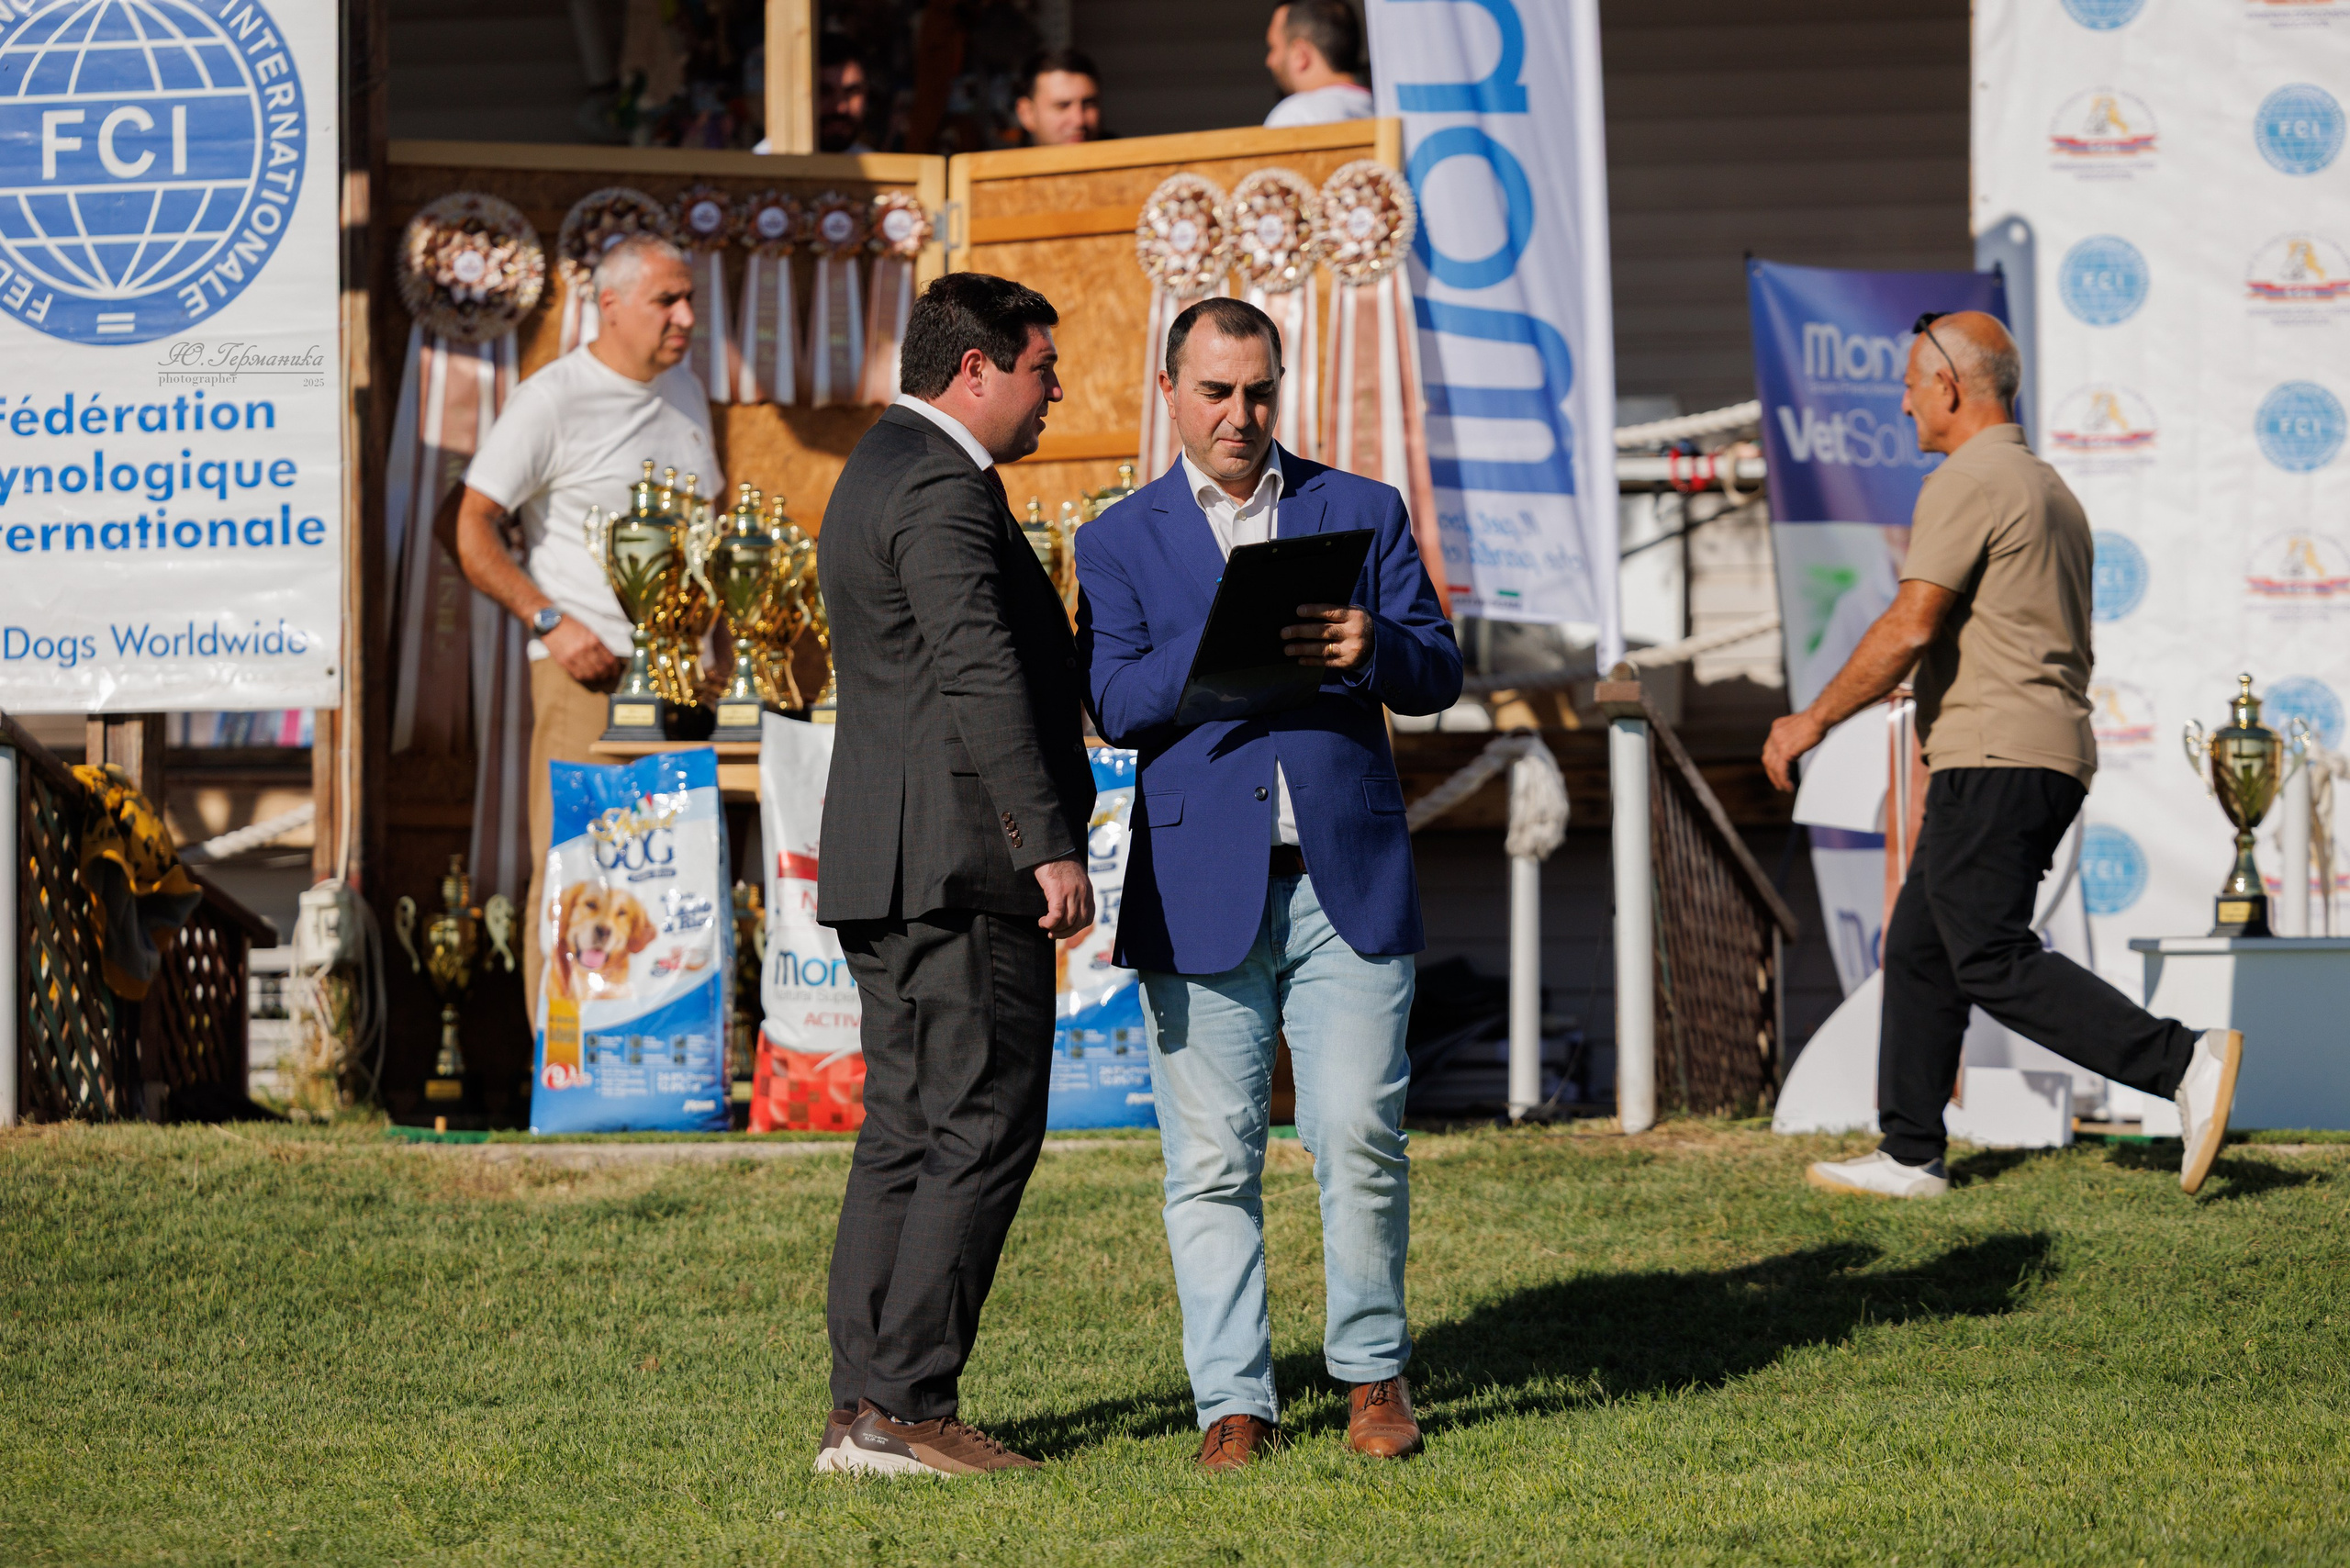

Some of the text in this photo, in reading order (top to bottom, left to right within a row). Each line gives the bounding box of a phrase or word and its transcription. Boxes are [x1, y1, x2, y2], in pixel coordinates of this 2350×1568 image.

[41, 105, 188, 181] FCI
[2278, 118, 2321, 140] FCI
[177, 0, 301, 319] INTERNATIONALE
[2080, 269, 2125, 292] FCI
[1803, 322, 1917, 380] Mon
[2279, 417, 2322, 438] FCI
[0, 503, 327, 552] ernationale
[3, 619, 308, 668] Dogs Worldwide
